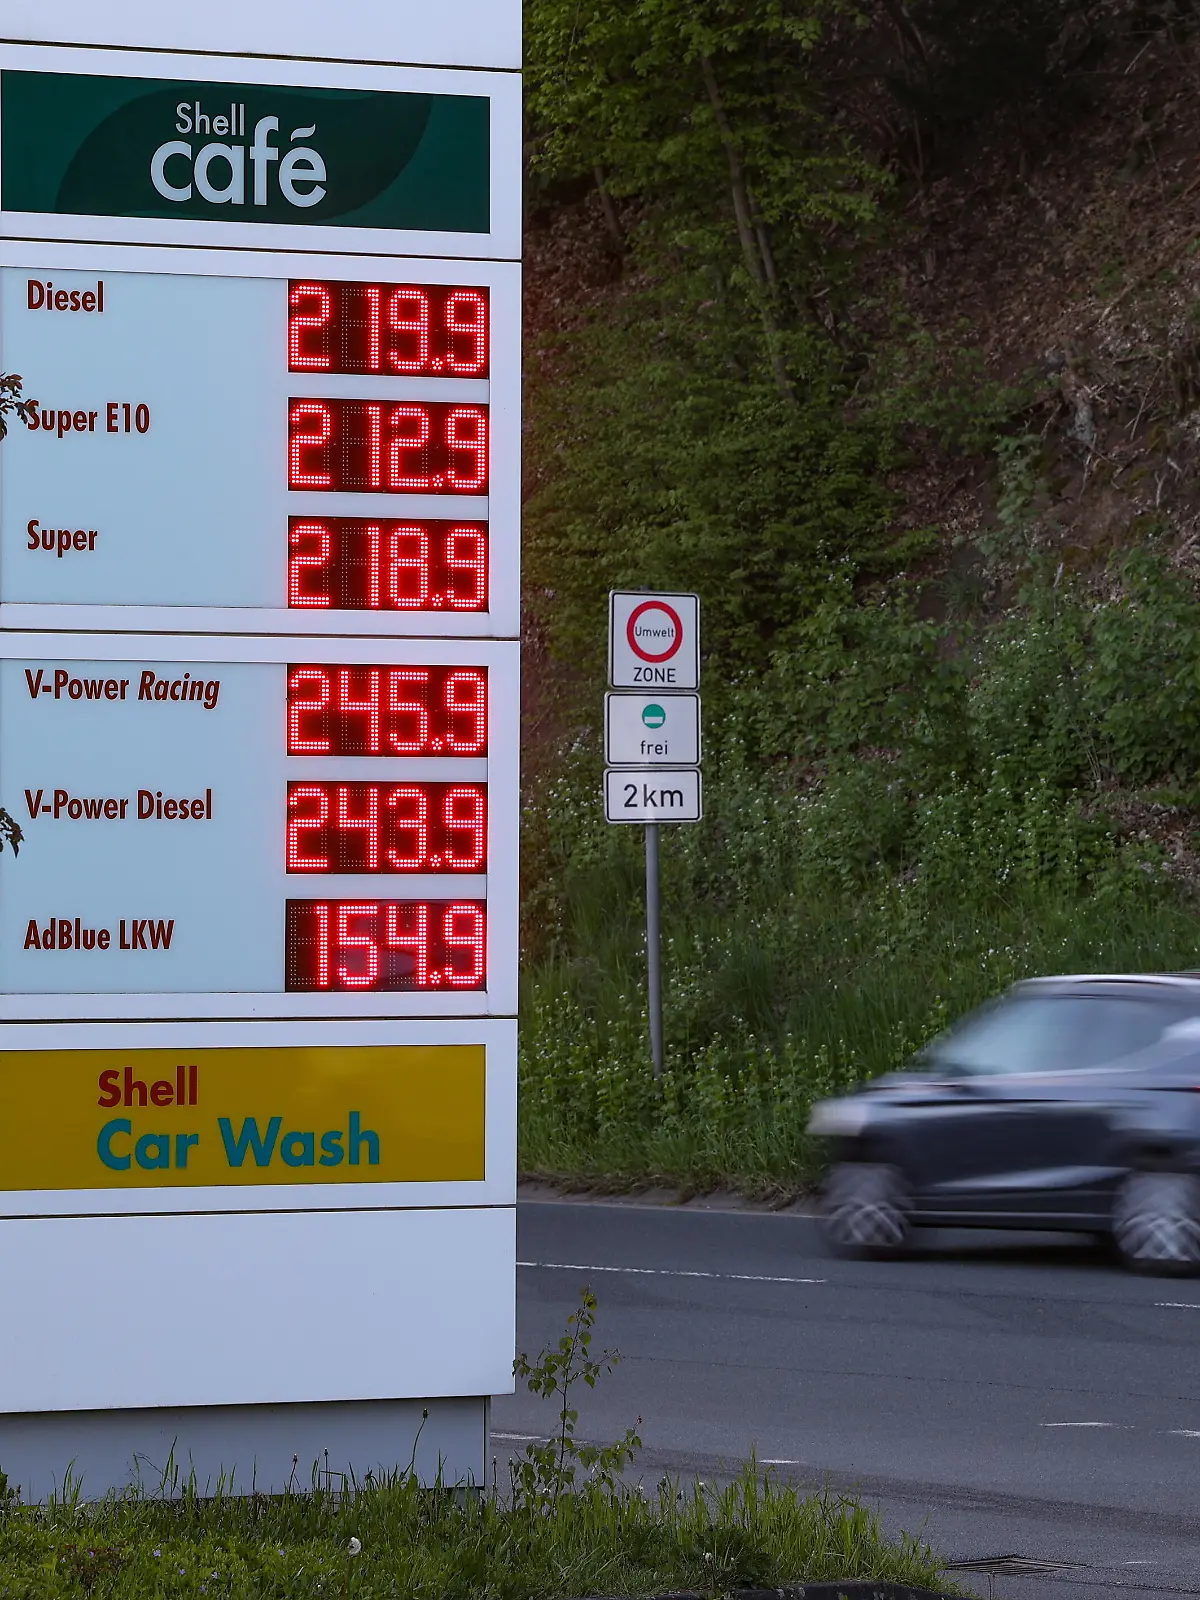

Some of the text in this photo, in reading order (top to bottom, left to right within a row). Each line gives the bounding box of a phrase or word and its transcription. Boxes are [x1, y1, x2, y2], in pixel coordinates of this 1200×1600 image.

[175, 102, 245, 137] Shell
[150, 115, 327, 208] café
[27, 280, 104, 313] Diesel
[290, 285, 485, 372] 219.9
[27, 400, 150, 438] Super E10
[290, 404, 485, 489] 212.9
[27, 519, 98, 558] Super
[290, 525, 485, 608] 218.9
[634, 626, 675, 638] Umwelt
[24, 669, 220, 708] V-Power Racing
[633, 667, 677, 683] ZONE
[289, 670, 485, 751] 245.9
[640, 740, 669, 755] frei
[24, 788, 213, 820] V-Power Diesel
[288, 787, 484, 868] 243.9
[24, 919, 174, 950] AdBlue LKW
[315, 904, 484, 986] 154.9
[97, 1065, 199, 1108] Shell
[96, 1111, 380, 1171] Car Wash
